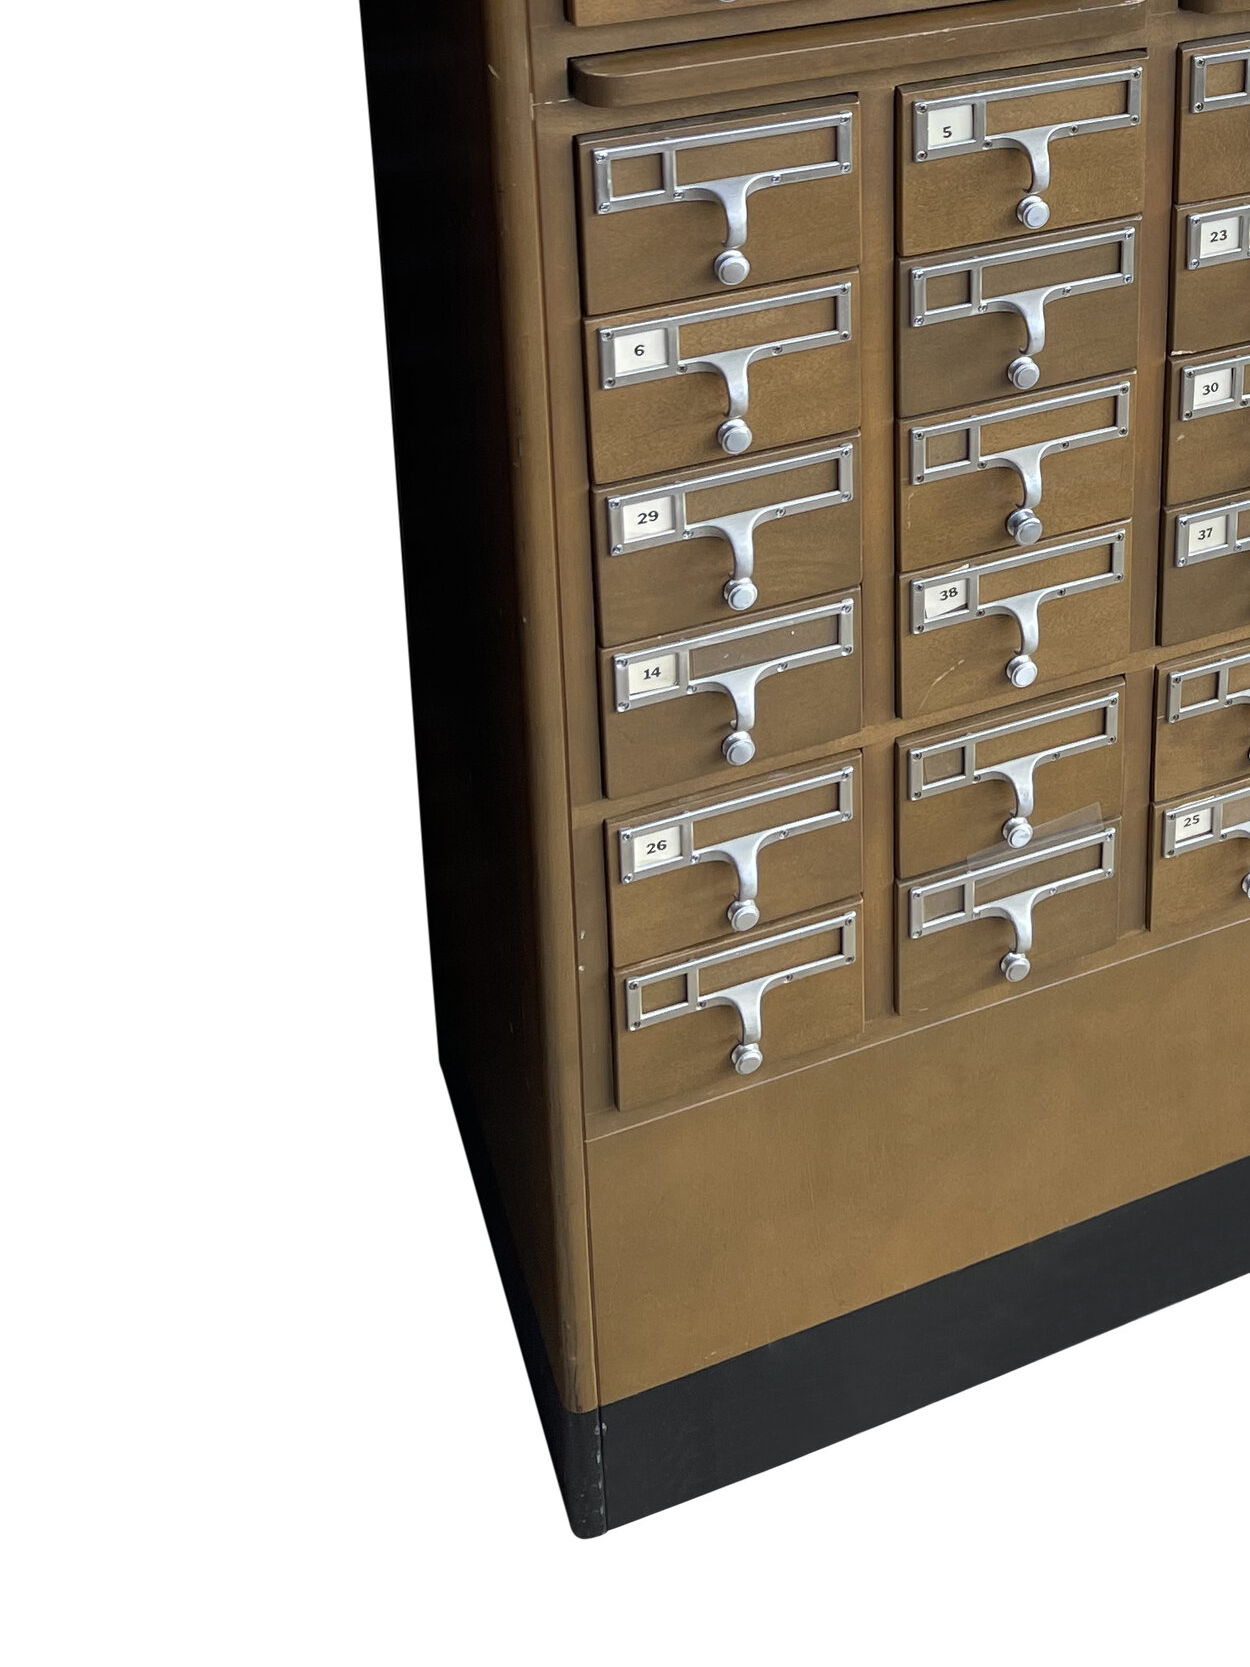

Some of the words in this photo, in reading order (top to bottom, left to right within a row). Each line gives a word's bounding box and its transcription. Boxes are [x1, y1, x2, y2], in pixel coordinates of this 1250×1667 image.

[942, 125, 953, 139] 5
[1210, 229, 1228, 243] 23
[634, 344, 645, 357] 6
[1202, 382, 1219, 396] 30
[637, 510, 659, 525] 29
[1197, 527, 1213, 541] 37
[940, 587, 959, 601] 38
[643, 666, 661, 680] 14
[1183, 814, 1200, 828] 25
[646, 839, 667, 855] 26
